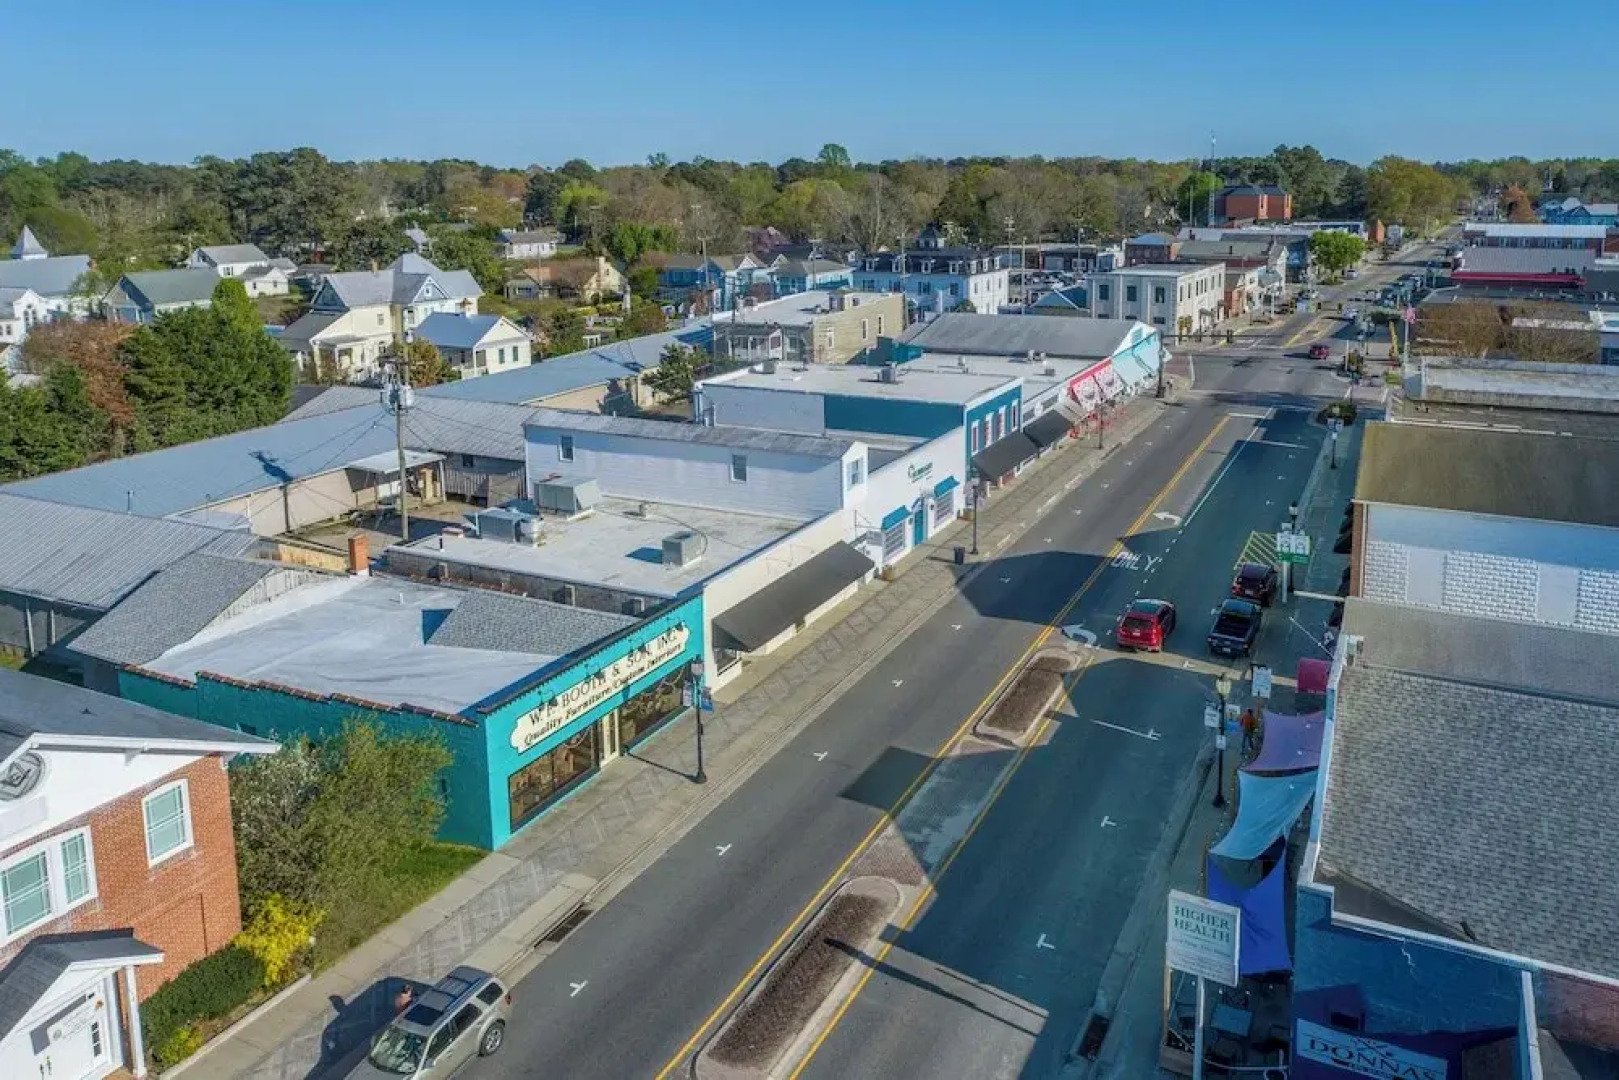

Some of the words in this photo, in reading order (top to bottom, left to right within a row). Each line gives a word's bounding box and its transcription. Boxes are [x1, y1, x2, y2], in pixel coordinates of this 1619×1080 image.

[561, 669, 607, 708] BOOTH
[612, 664, 621, 678] &
[525, 717, 563, 746] Quality
[565, 687, 612, 719] Furniture
[1174, 905, 1231, 930] HIGHER
[1174, 917, 1231, 943] HEALTH
